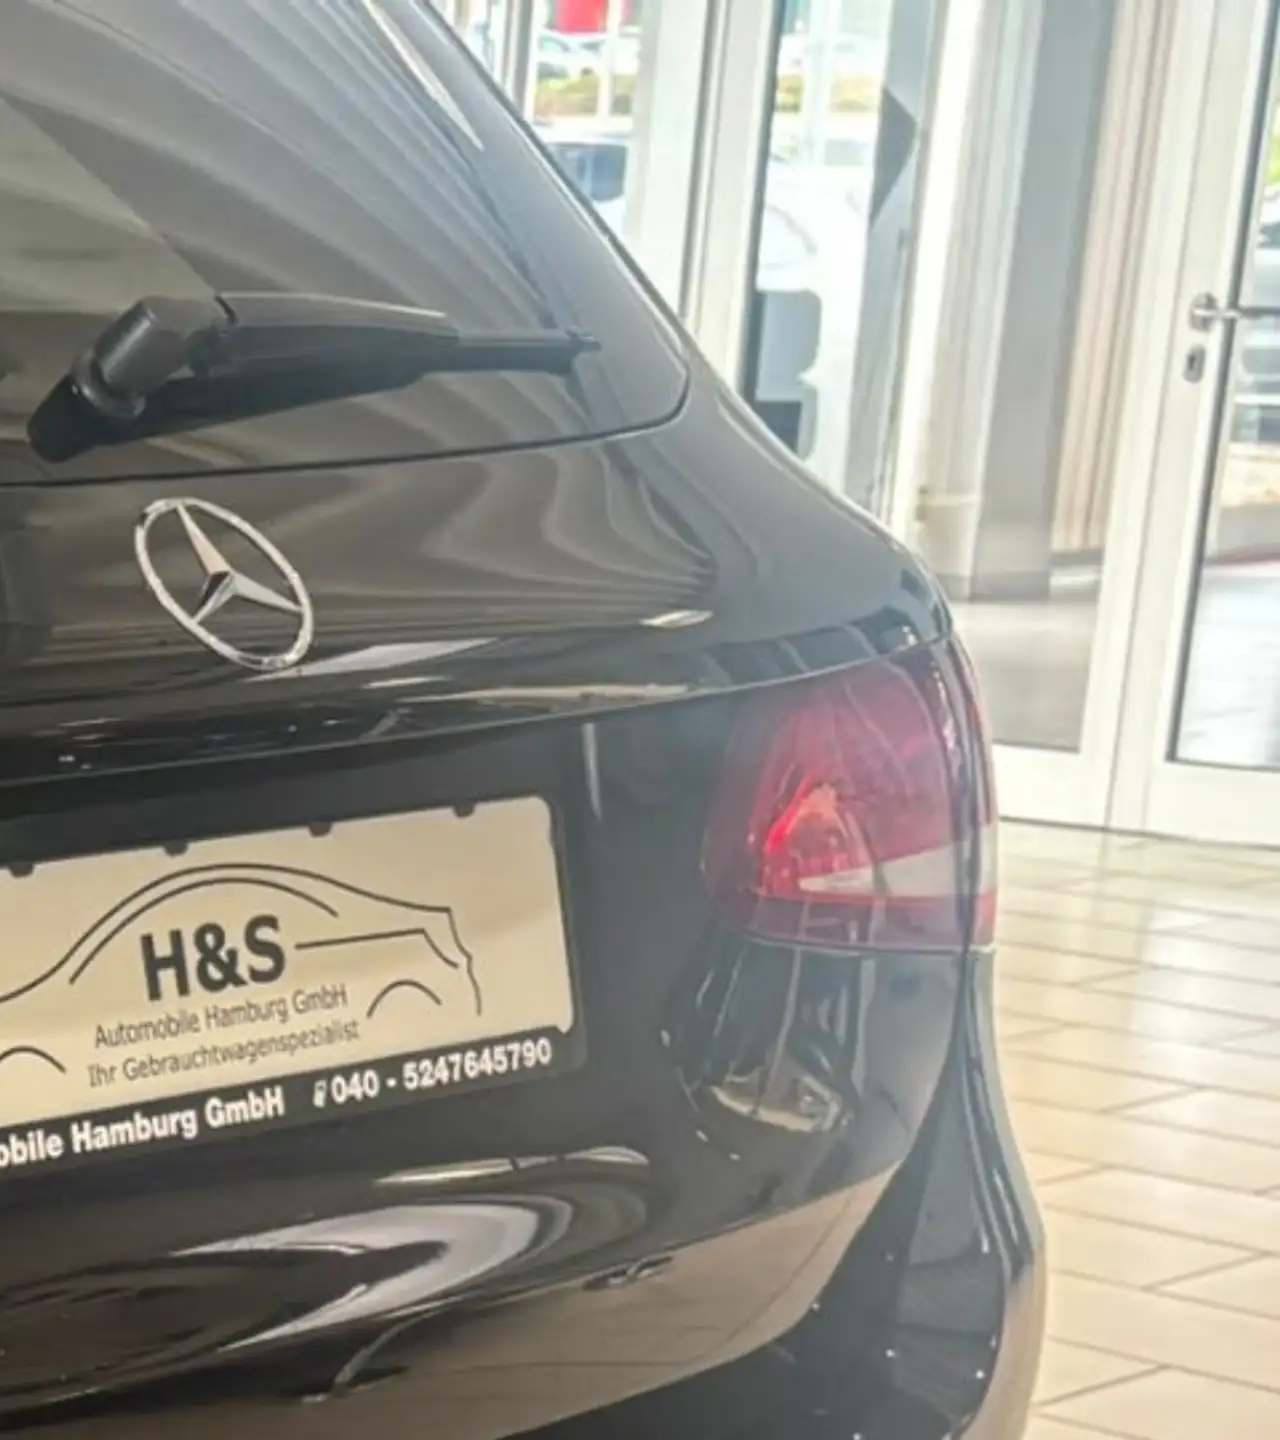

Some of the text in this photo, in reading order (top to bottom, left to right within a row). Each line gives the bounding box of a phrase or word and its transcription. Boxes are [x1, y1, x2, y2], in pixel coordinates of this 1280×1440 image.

[140, 913, 286, 1002] H&S
[87, 1019, 361, 1088] Ihr Gebrauchtwagenspezialist
[94, 983, 349, 1049] Automobile Hamburg GmbH
[69, 1106, 199, 1154] Hamburg
[204, 1084, 286, 1129] GmbH
[330, 1068, 381, 1105] 040
[402, 1036, 553, 1090] 5247645790
